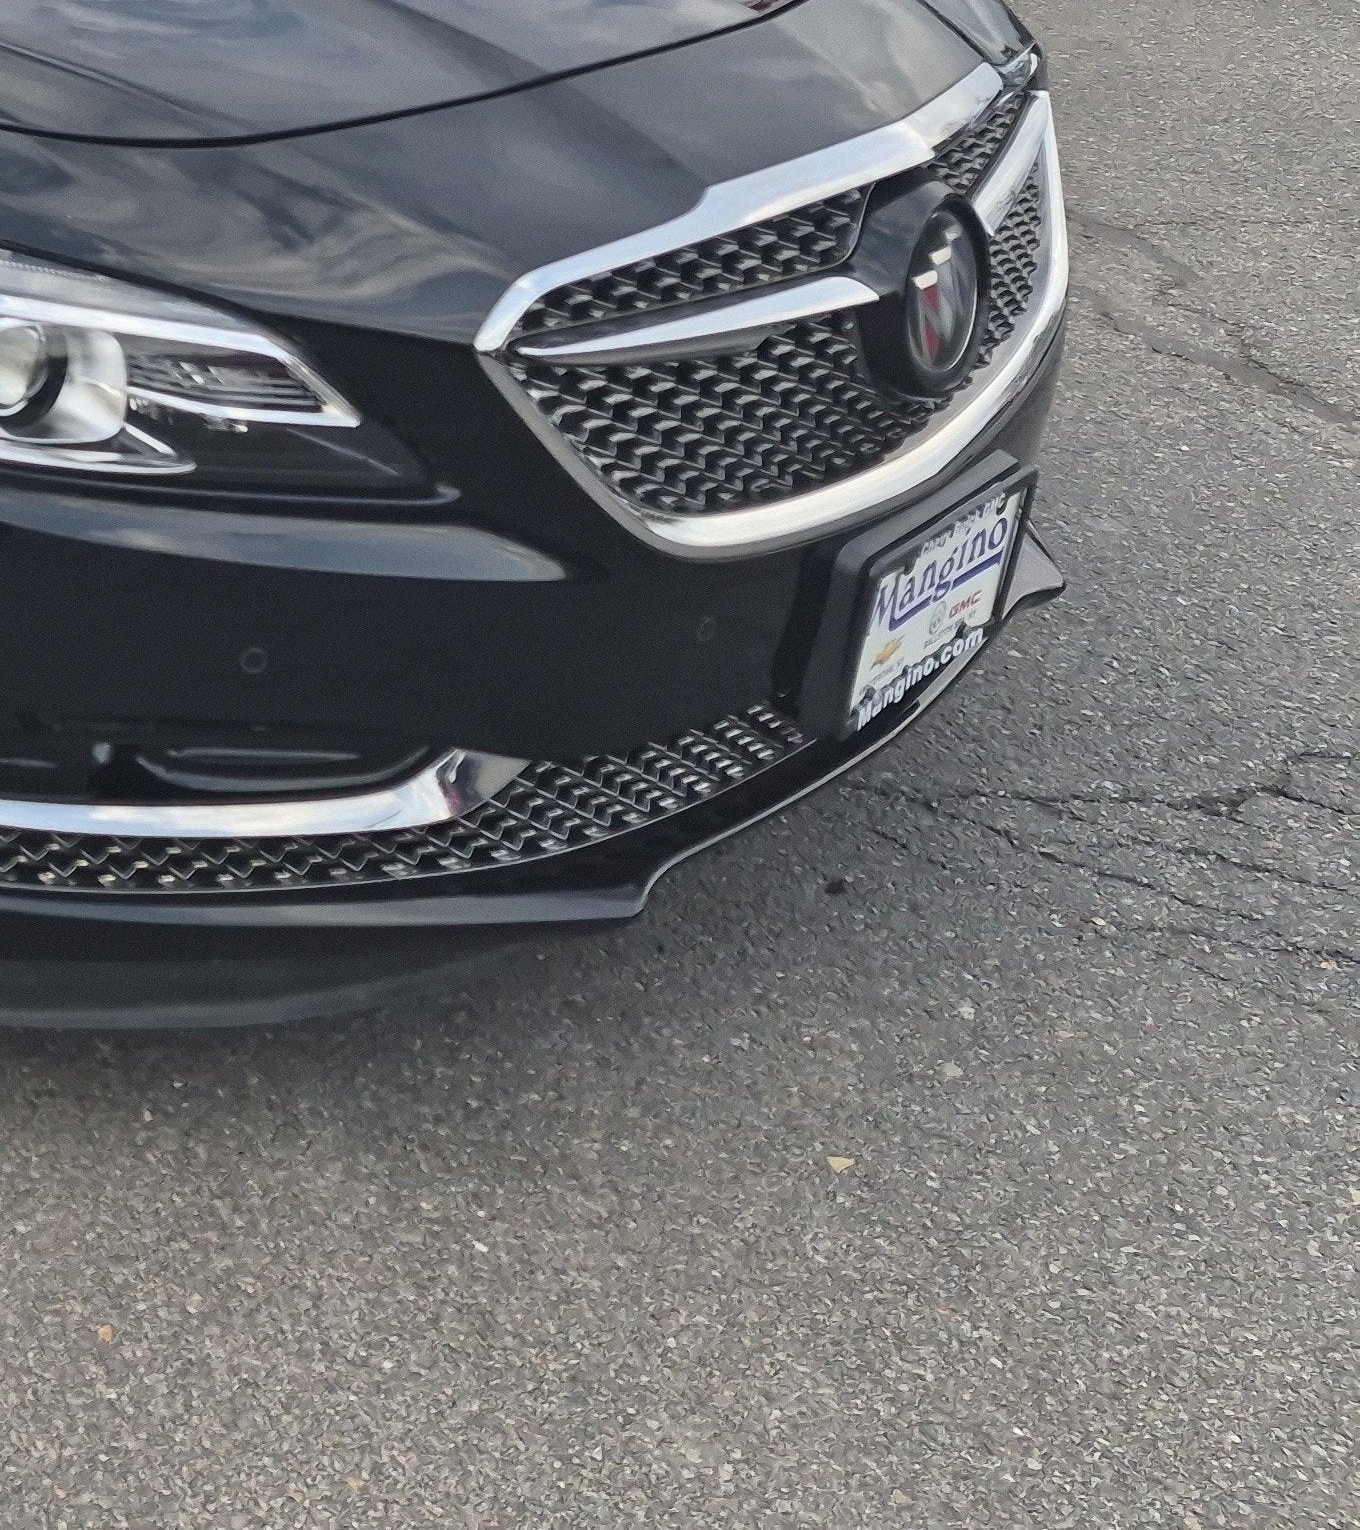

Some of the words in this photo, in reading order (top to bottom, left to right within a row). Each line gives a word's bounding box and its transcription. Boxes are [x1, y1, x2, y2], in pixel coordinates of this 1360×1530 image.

[873, 518, 1008, 631] Mangino
[949, 590, 982, 620] GMC
[856, 628, 984, 732] Mangino.com
